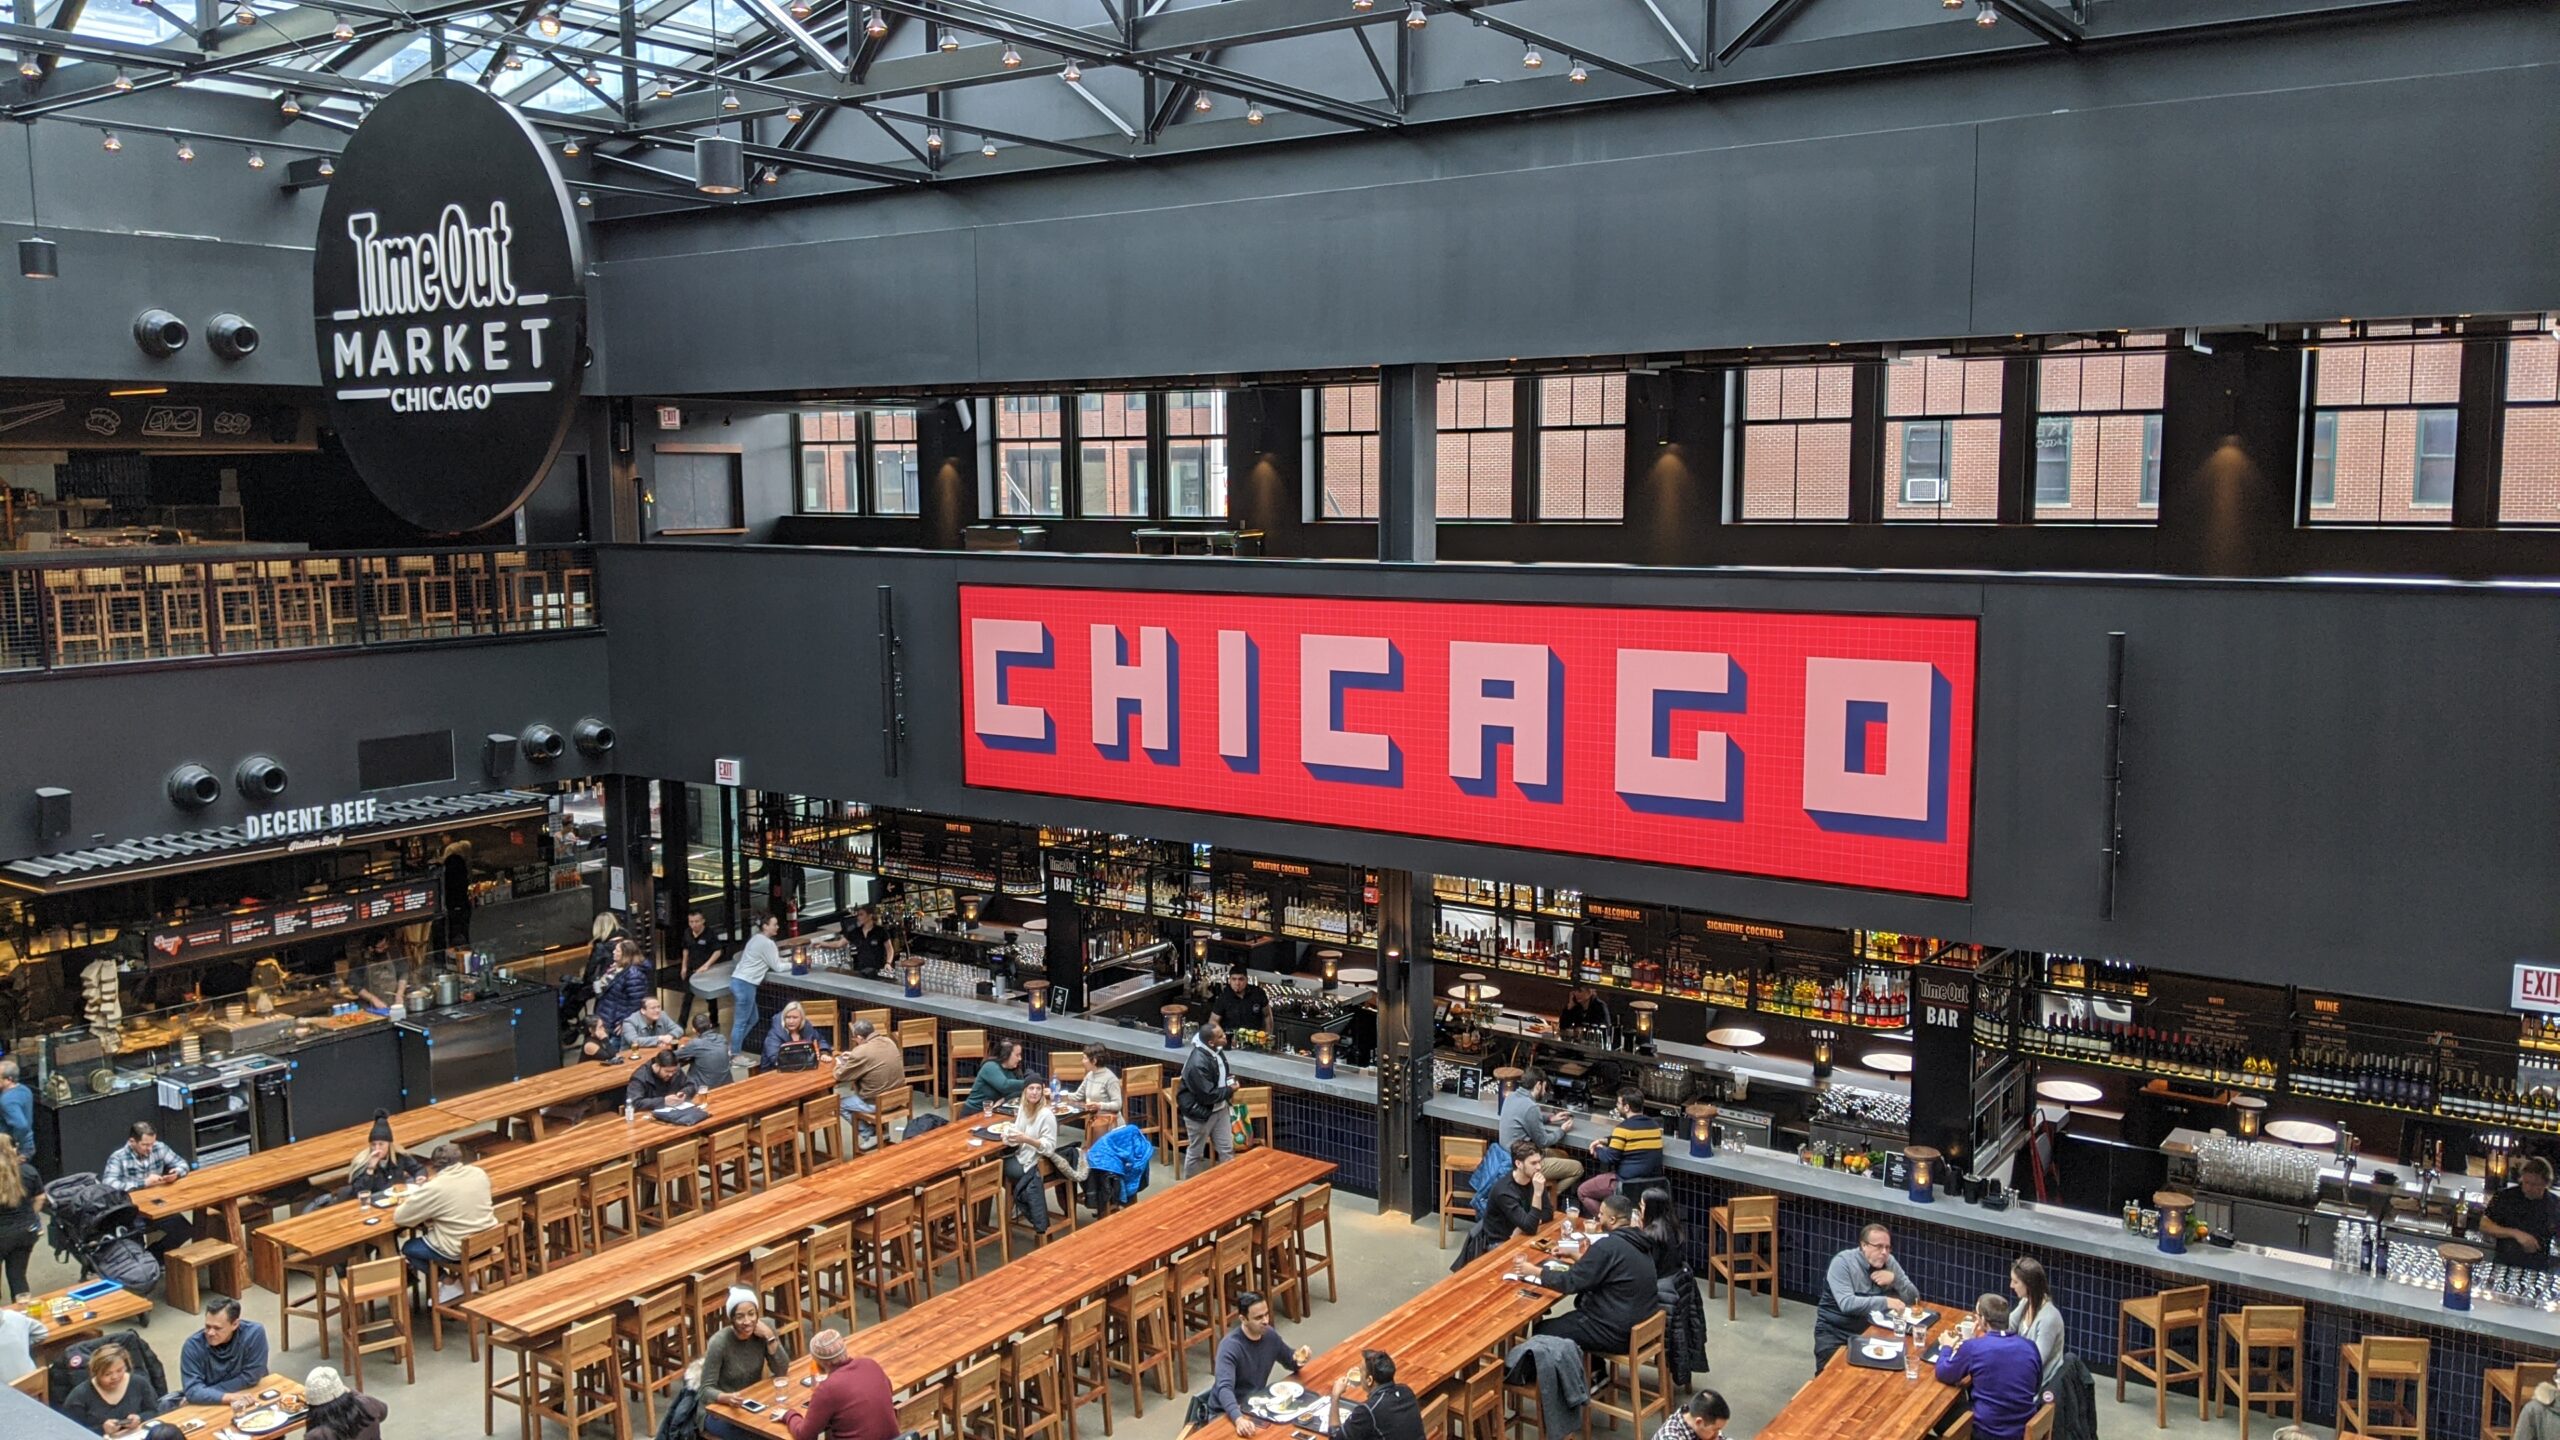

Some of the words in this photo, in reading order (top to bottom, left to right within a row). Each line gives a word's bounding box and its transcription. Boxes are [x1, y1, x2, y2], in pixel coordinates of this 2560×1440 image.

[333, 318, 550, 379] MARKET
[391, 384, 491, 412] CHICAGO
[971, 616, 1950, 840] CHICAGO
[719, 761, 732, 777] EXIT
[246, 806, 324, 840] DECENT
[330, 798, 377, 828] BEEF
[1252, 860, 1280, 872] SIGNATURE
[1281, 864, 1309, 875] COCKTAILS
[1053, 876, 1072, 892] BAR
[1588, 904, 1640, 919] NON-ALCOHOLIC
[1706, 920, 1744, 934] SIGNATURE
[1745, 925, 1784, 939] COCKTAILS
[2522, 969, 2560, 998] EXIT
[1926, 1005, 1959, 1028] BAR
[2314, 999, 2340, 1013] WINE
